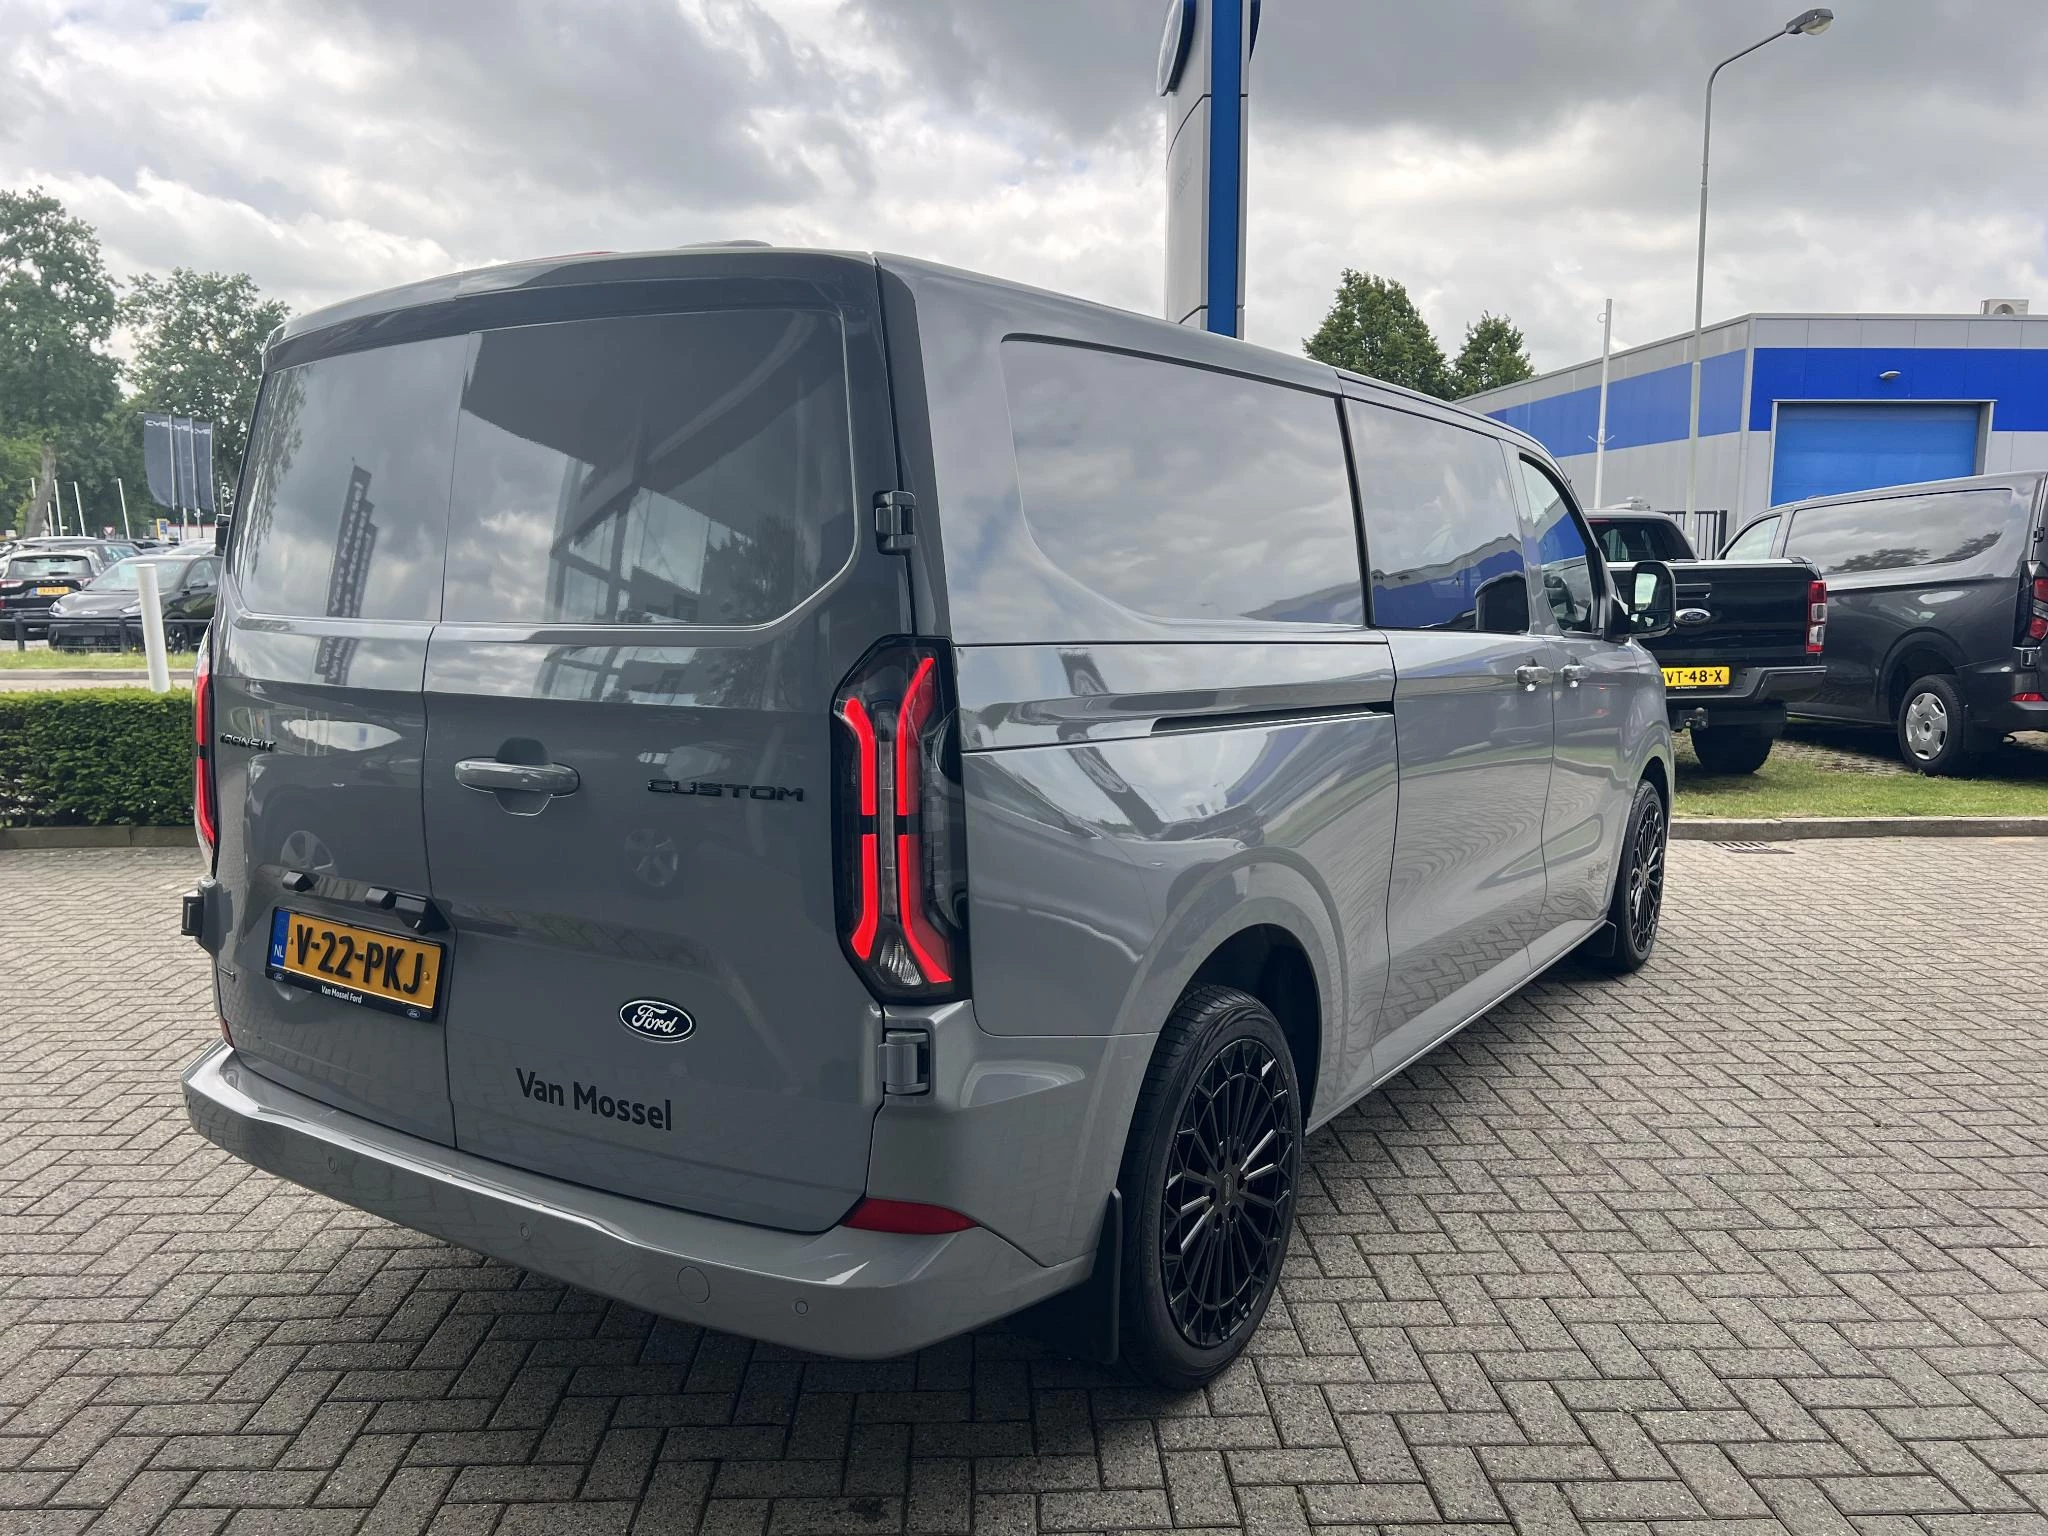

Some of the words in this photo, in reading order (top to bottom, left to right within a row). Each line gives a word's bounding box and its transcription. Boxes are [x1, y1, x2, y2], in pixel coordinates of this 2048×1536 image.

[1662, 669, 1723, 684] VT-48-X
[647, 779, 804, 802] CUSTOM
[274, 944, 285, 959] NL
[296, 923, 424, 995] V-22-PKJ
[321, 985, 331, 996] Van
[331, 987, 350, 1001] Mossel
[349, 992, 363, 1004] Ford
[631, 1004, 679, 1034] Ford
[515, 1067, 565, 1107] Van
[574, 1081, 672, 1131] Mossel
